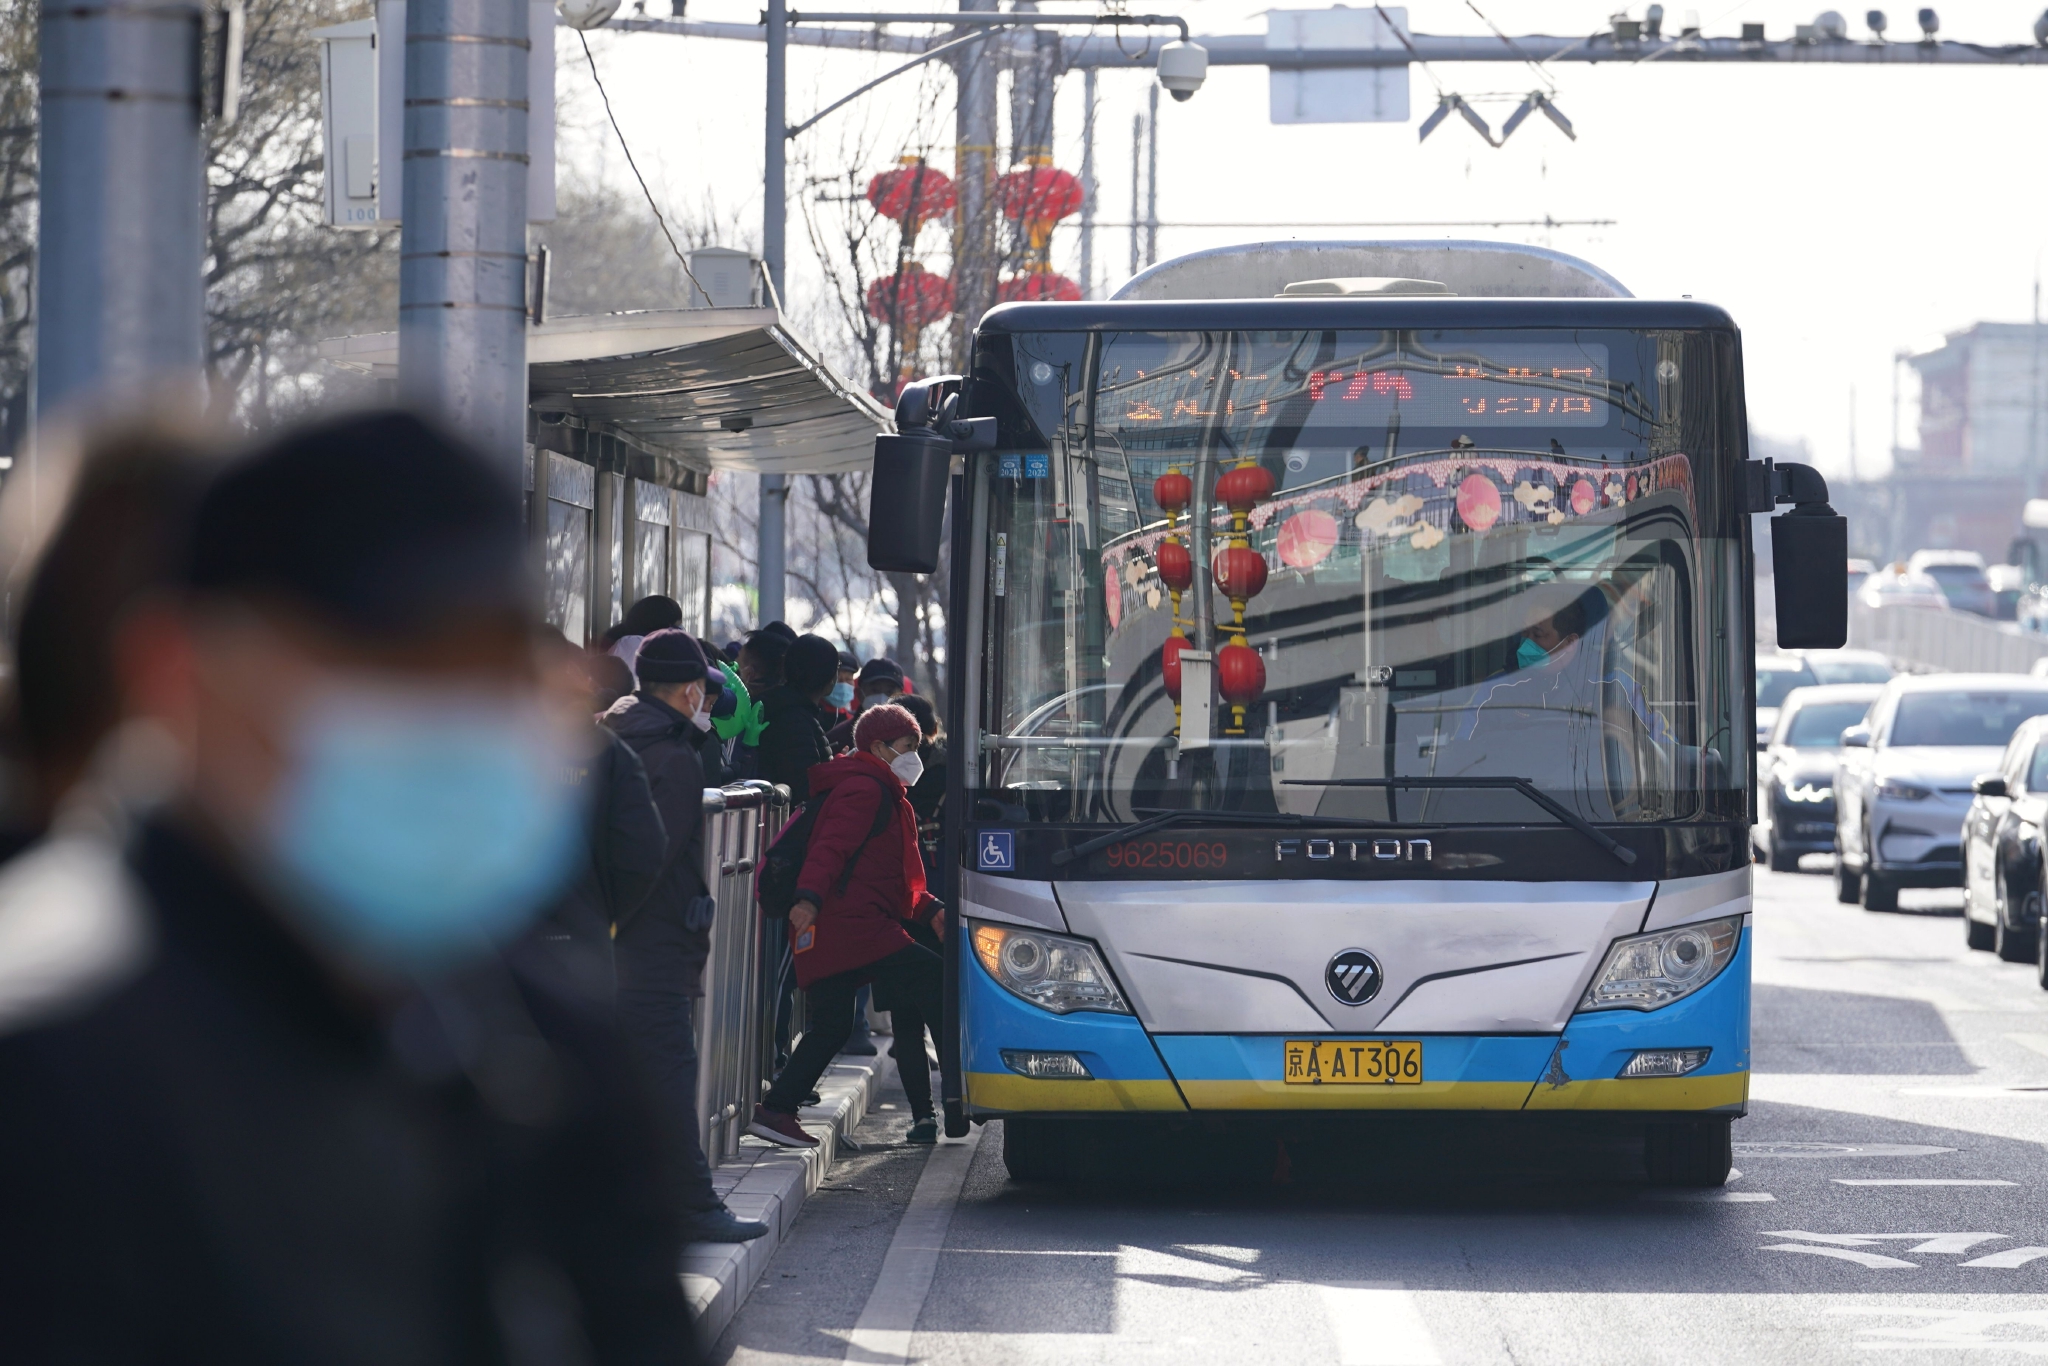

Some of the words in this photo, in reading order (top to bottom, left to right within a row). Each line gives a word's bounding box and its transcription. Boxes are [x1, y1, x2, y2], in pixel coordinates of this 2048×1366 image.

[1027, 469, 1046, 477] 2022
[1106, 842, 1227, 868] 9625069
[1275, 839, 1432, 861] FOTON
